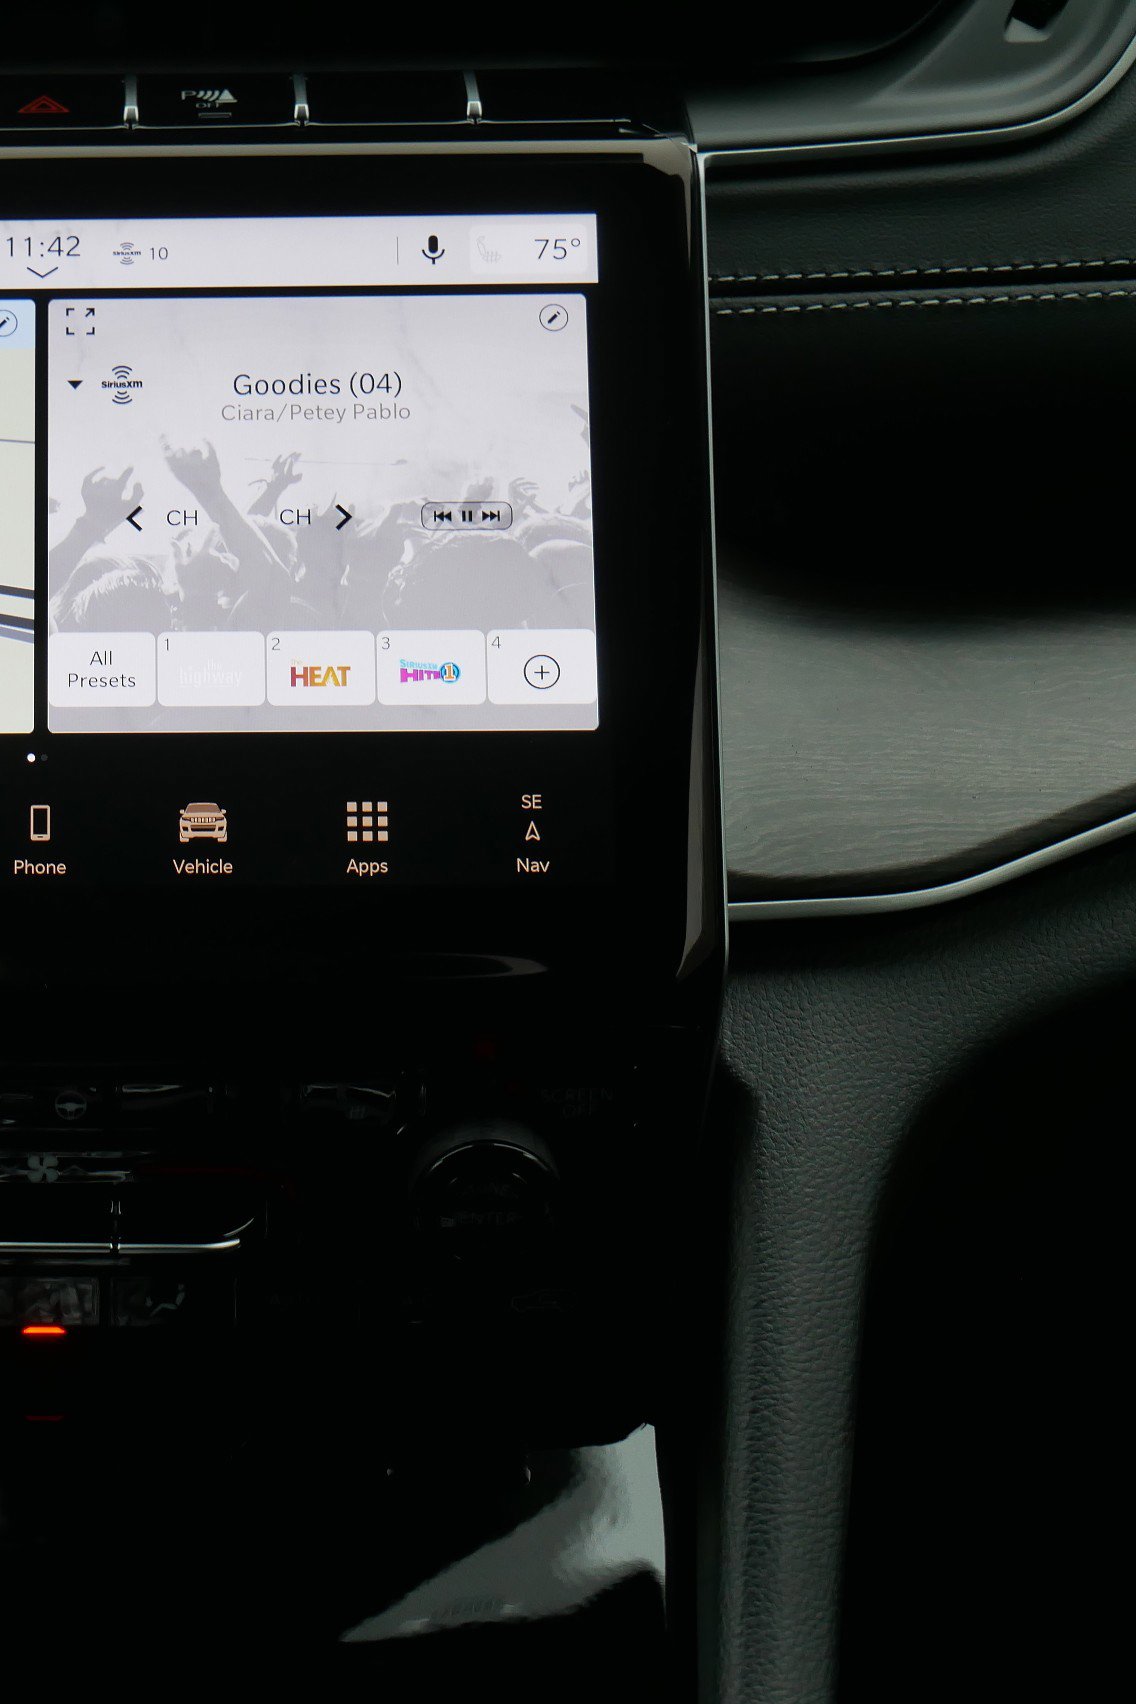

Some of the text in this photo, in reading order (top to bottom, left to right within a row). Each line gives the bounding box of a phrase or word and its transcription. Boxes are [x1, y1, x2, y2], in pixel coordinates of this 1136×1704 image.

[6, 236, 81, 258] 11:42
[150, 246, 169, 261] 10
[534, 237, 581, 260] 75°
[233, 371, 403, 398] Goodies (04)
[221, 402, 411, 424] Ciara/Petey Pablo
[166, 508, 199, 526] CH
[280, 508, 312, 525] CH
[164, 638, 170, 651] 1
[271, 637, 281, 651] 2
[381, 636, 391, 650] 3
[491, 635, 502, 649] 4
[89, 650, 113, 666] All
[67, 672, 137, 688] Presets
[290, 666, 351, 687] HEAT
[521, 795, 542, 809] SE
[13, 859, 67, 875] Phone
[172, 859, 233, 875] Vehicle
[346, 859, 389, 876] Apps
[516, 858, 550, 873] Nav
